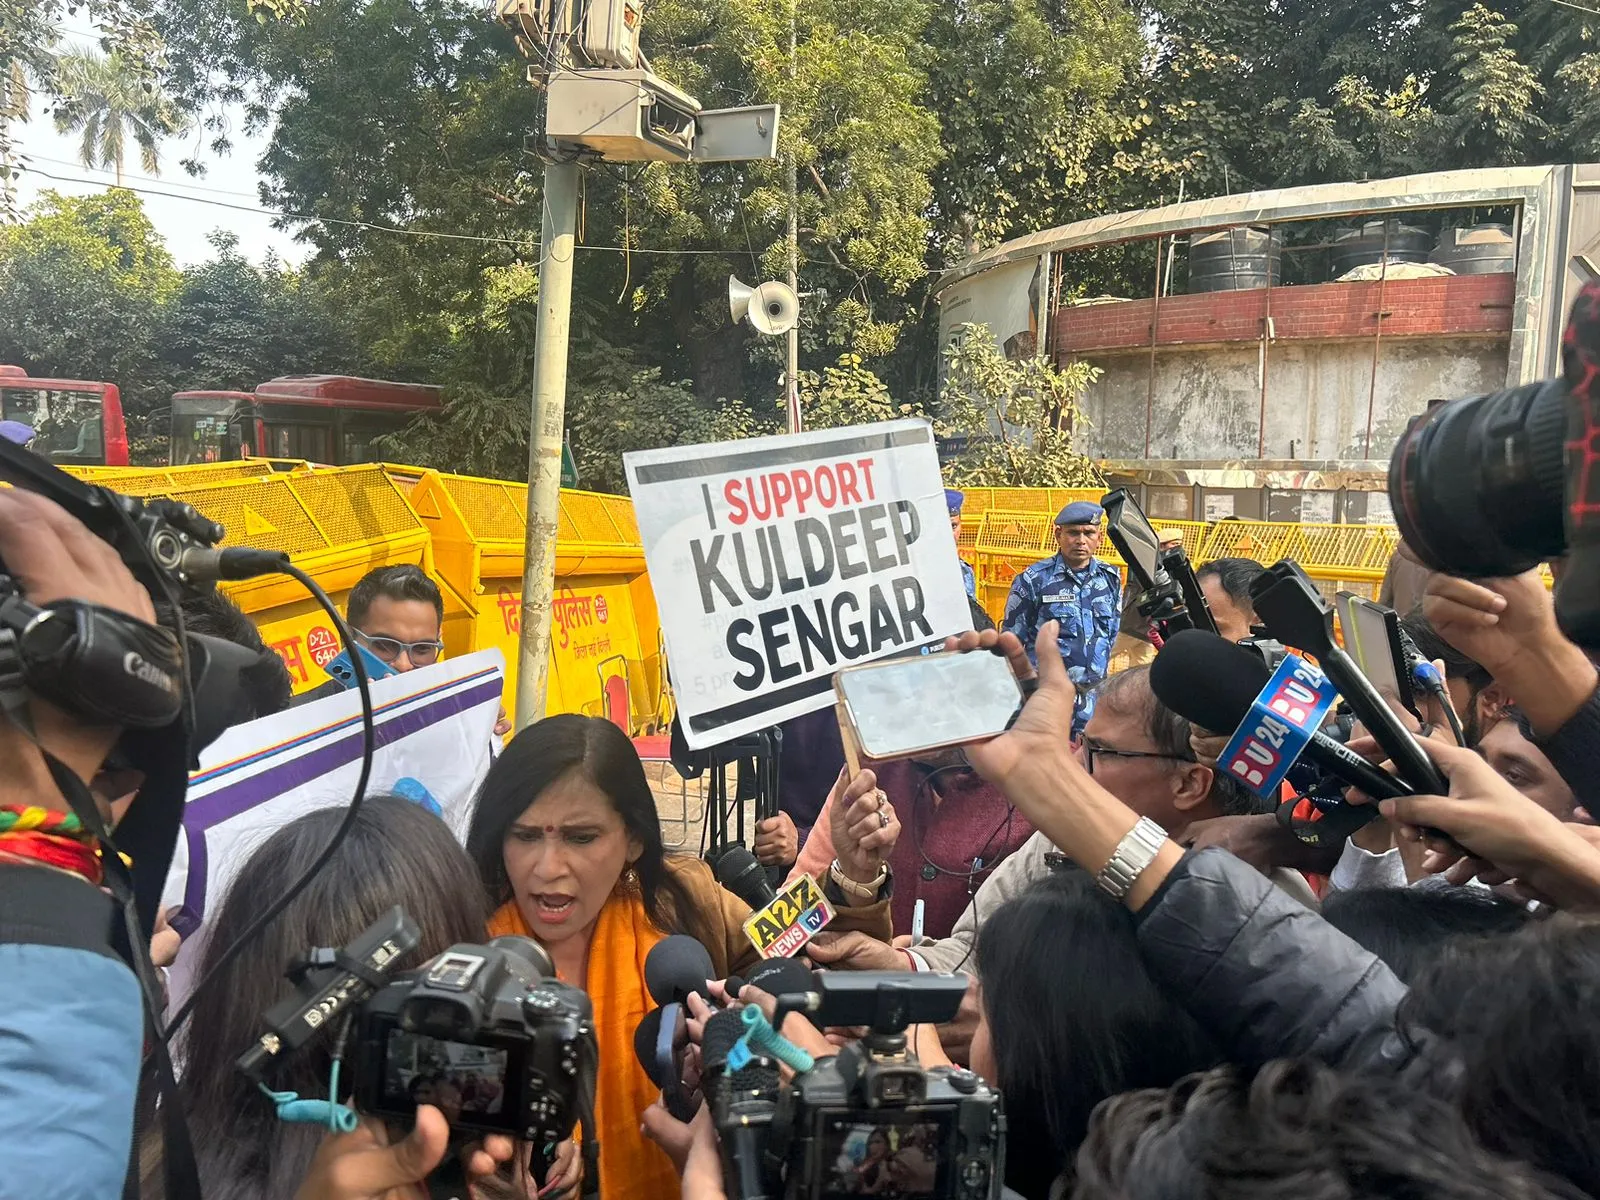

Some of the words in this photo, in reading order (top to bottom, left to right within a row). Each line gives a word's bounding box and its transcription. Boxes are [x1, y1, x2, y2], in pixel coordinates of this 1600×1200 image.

[701, 483, 717, 530] I
[724, 458, 875, 525] SUPPORT
[689, 499, 921, 614] KULDEEP
[552, 584, 593, 649] पुलिस
[726, 575, 934, 692] SENGAR
[1231, 715, 1292, 786] BU24
[754, 879, 820, 949] A2Z
[767, 926, 804, 958] NEWS
[807, 912, 820, 926] TV
